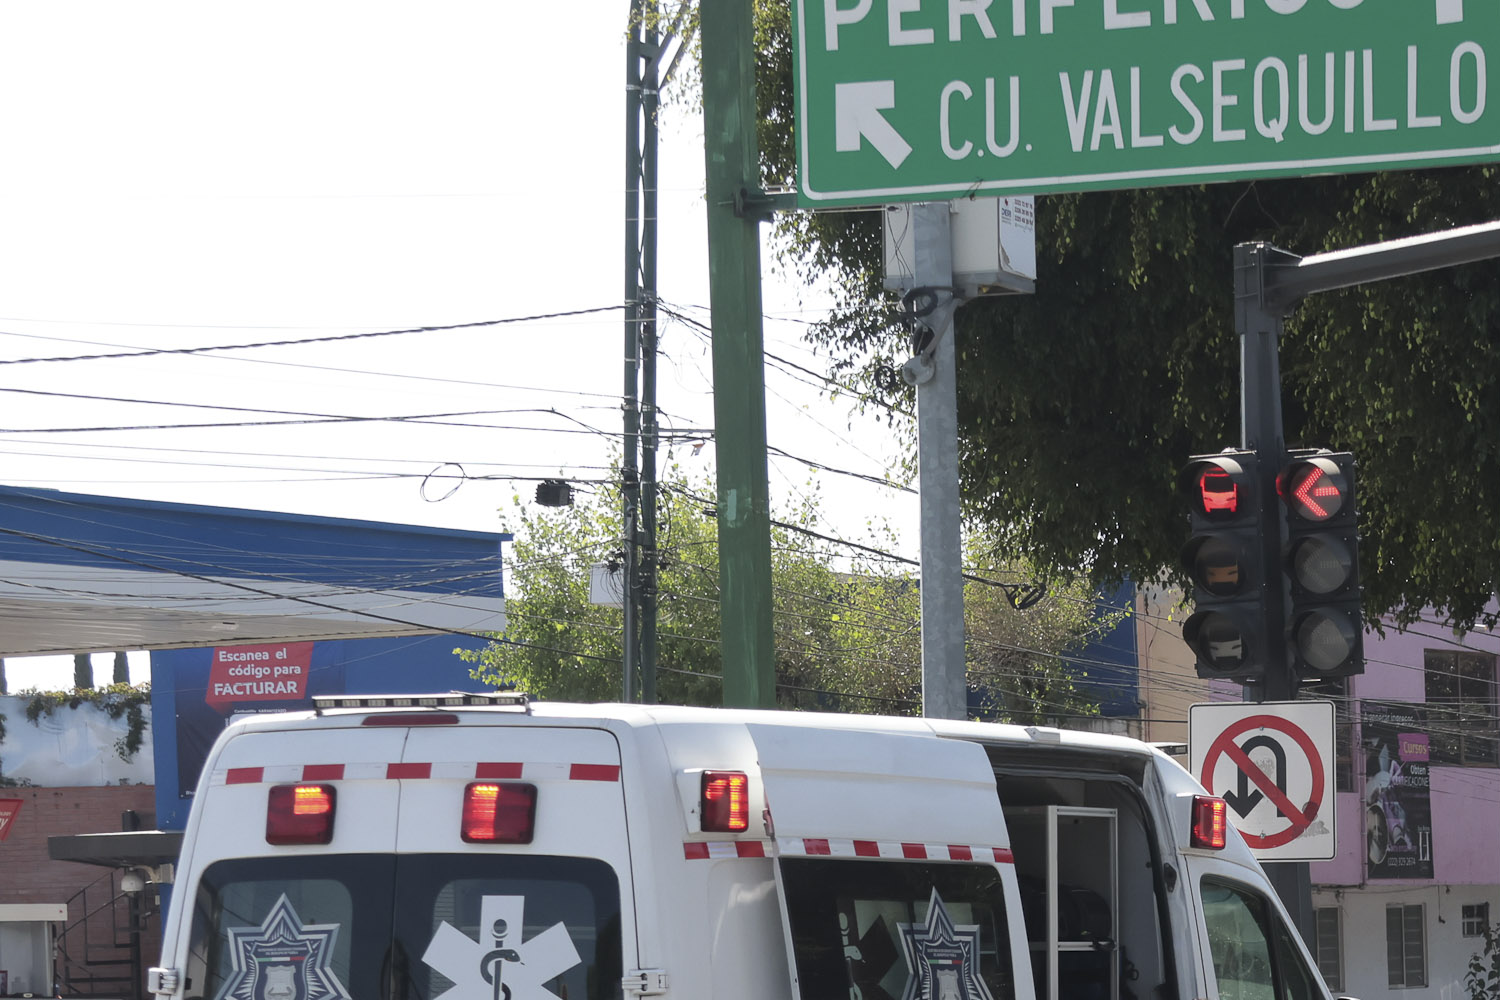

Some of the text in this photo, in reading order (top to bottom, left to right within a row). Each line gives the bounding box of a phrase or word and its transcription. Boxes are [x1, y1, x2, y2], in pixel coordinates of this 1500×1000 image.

[939, 41, 1488, 160] C.U. VALSEQUILLO
[219, 647, 287, 662] Escanea el
[228, 664, 301, 678] código para
[214, 681, 298, 695] FACTURAR
